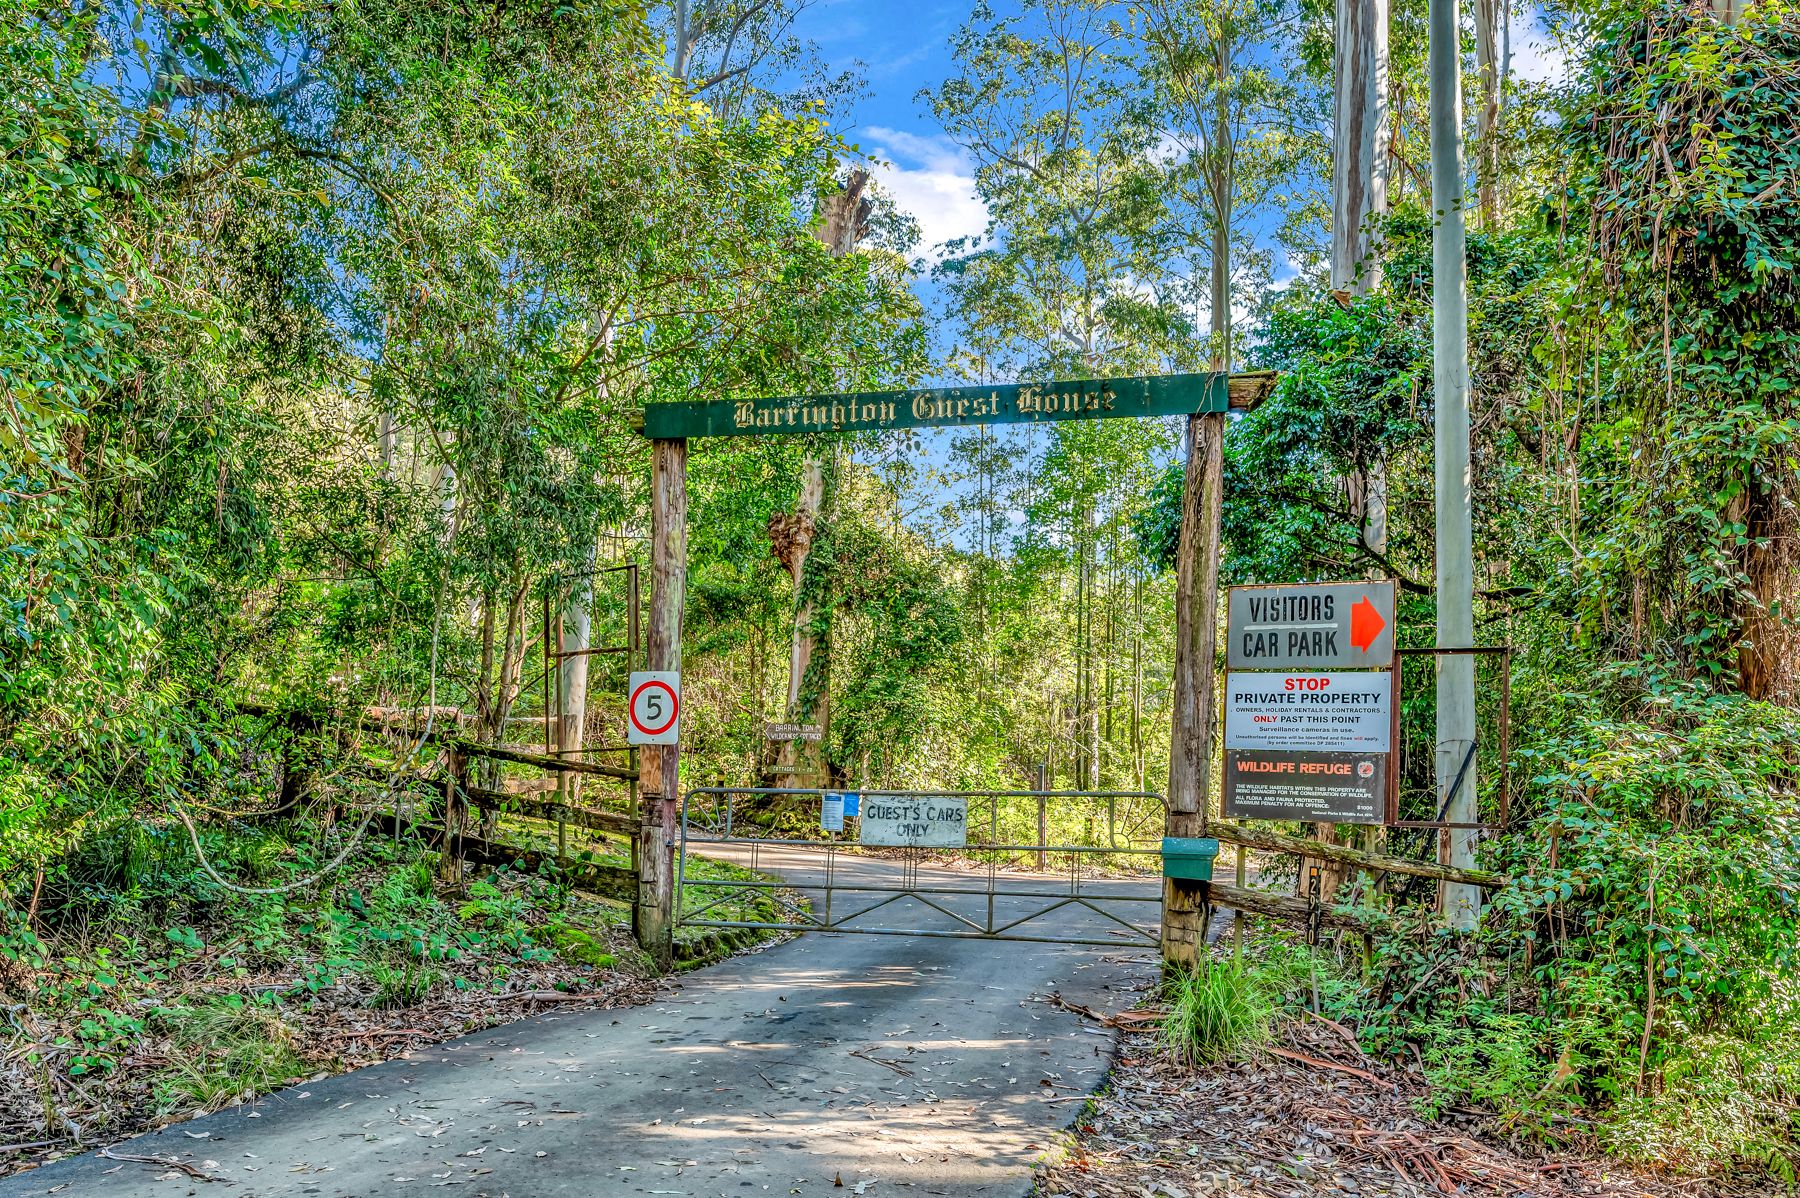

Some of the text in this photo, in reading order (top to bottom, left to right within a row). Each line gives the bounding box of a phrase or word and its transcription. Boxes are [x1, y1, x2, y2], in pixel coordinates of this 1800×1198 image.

[912, 391, 999, 420] Guest
[1017, 386, 1116, 419] House
[1249, 594, 1335, 622] VISITORS
[1243, 631, 1338, 657] CAR PARK
[1284, 678, 1330, 691] STOP
[1235, 693, 1381, 704] PRIVATE PROPERTY
[647, 695, 662, 720] 5
[1253, 715, 1278, 723] ONLY
[1280, 715, 1304, 723] PAST
[1331, 716, 1361, 724] POINT
[1237, 761, 1352, 775] WILDLIFE REFUGE
[867, 805, 963, 821] GUEST'S CARS
[896, 823, 929, 836] ONLY
